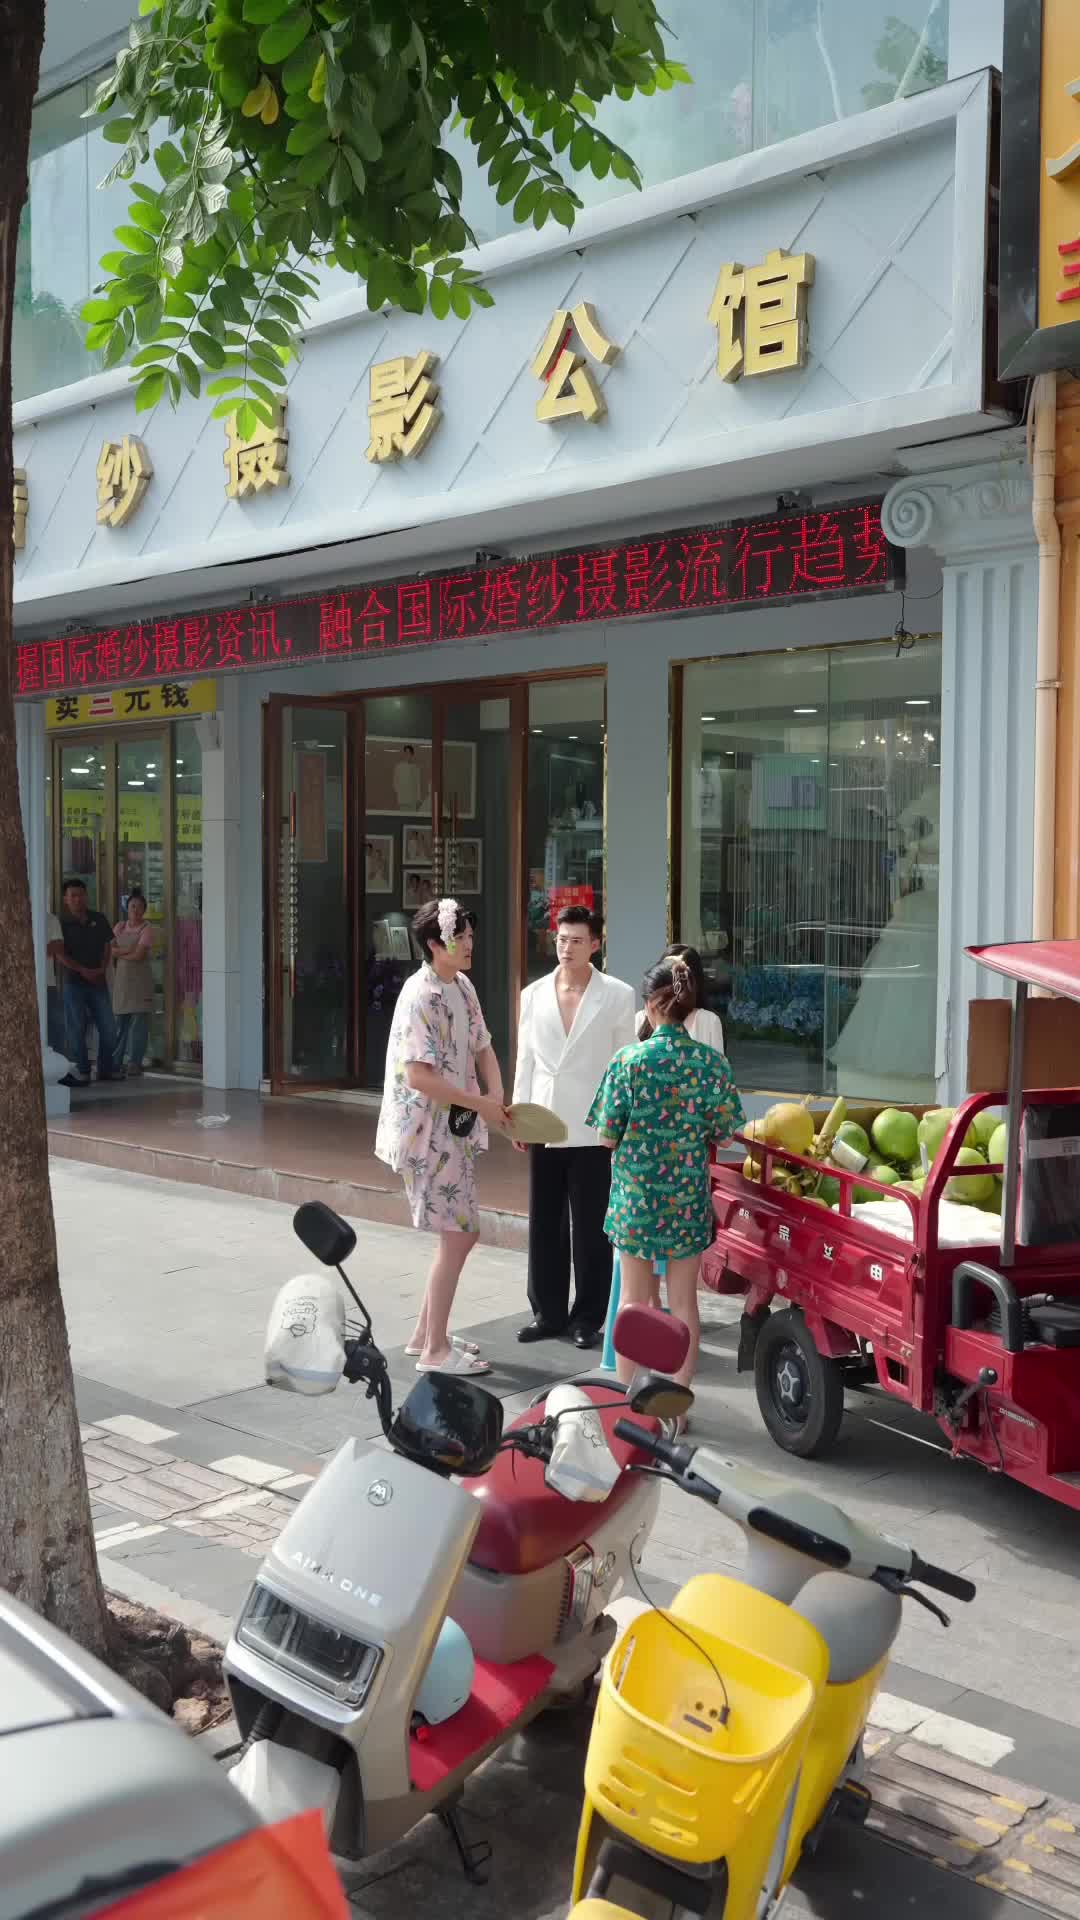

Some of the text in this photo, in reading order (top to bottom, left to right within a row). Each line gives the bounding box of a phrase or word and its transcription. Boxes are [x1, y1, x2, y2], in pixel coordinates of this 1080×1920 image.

[13, 248, 816, 550] 纱摄影公馆
[340, 1578, 384, 1608] ONE
